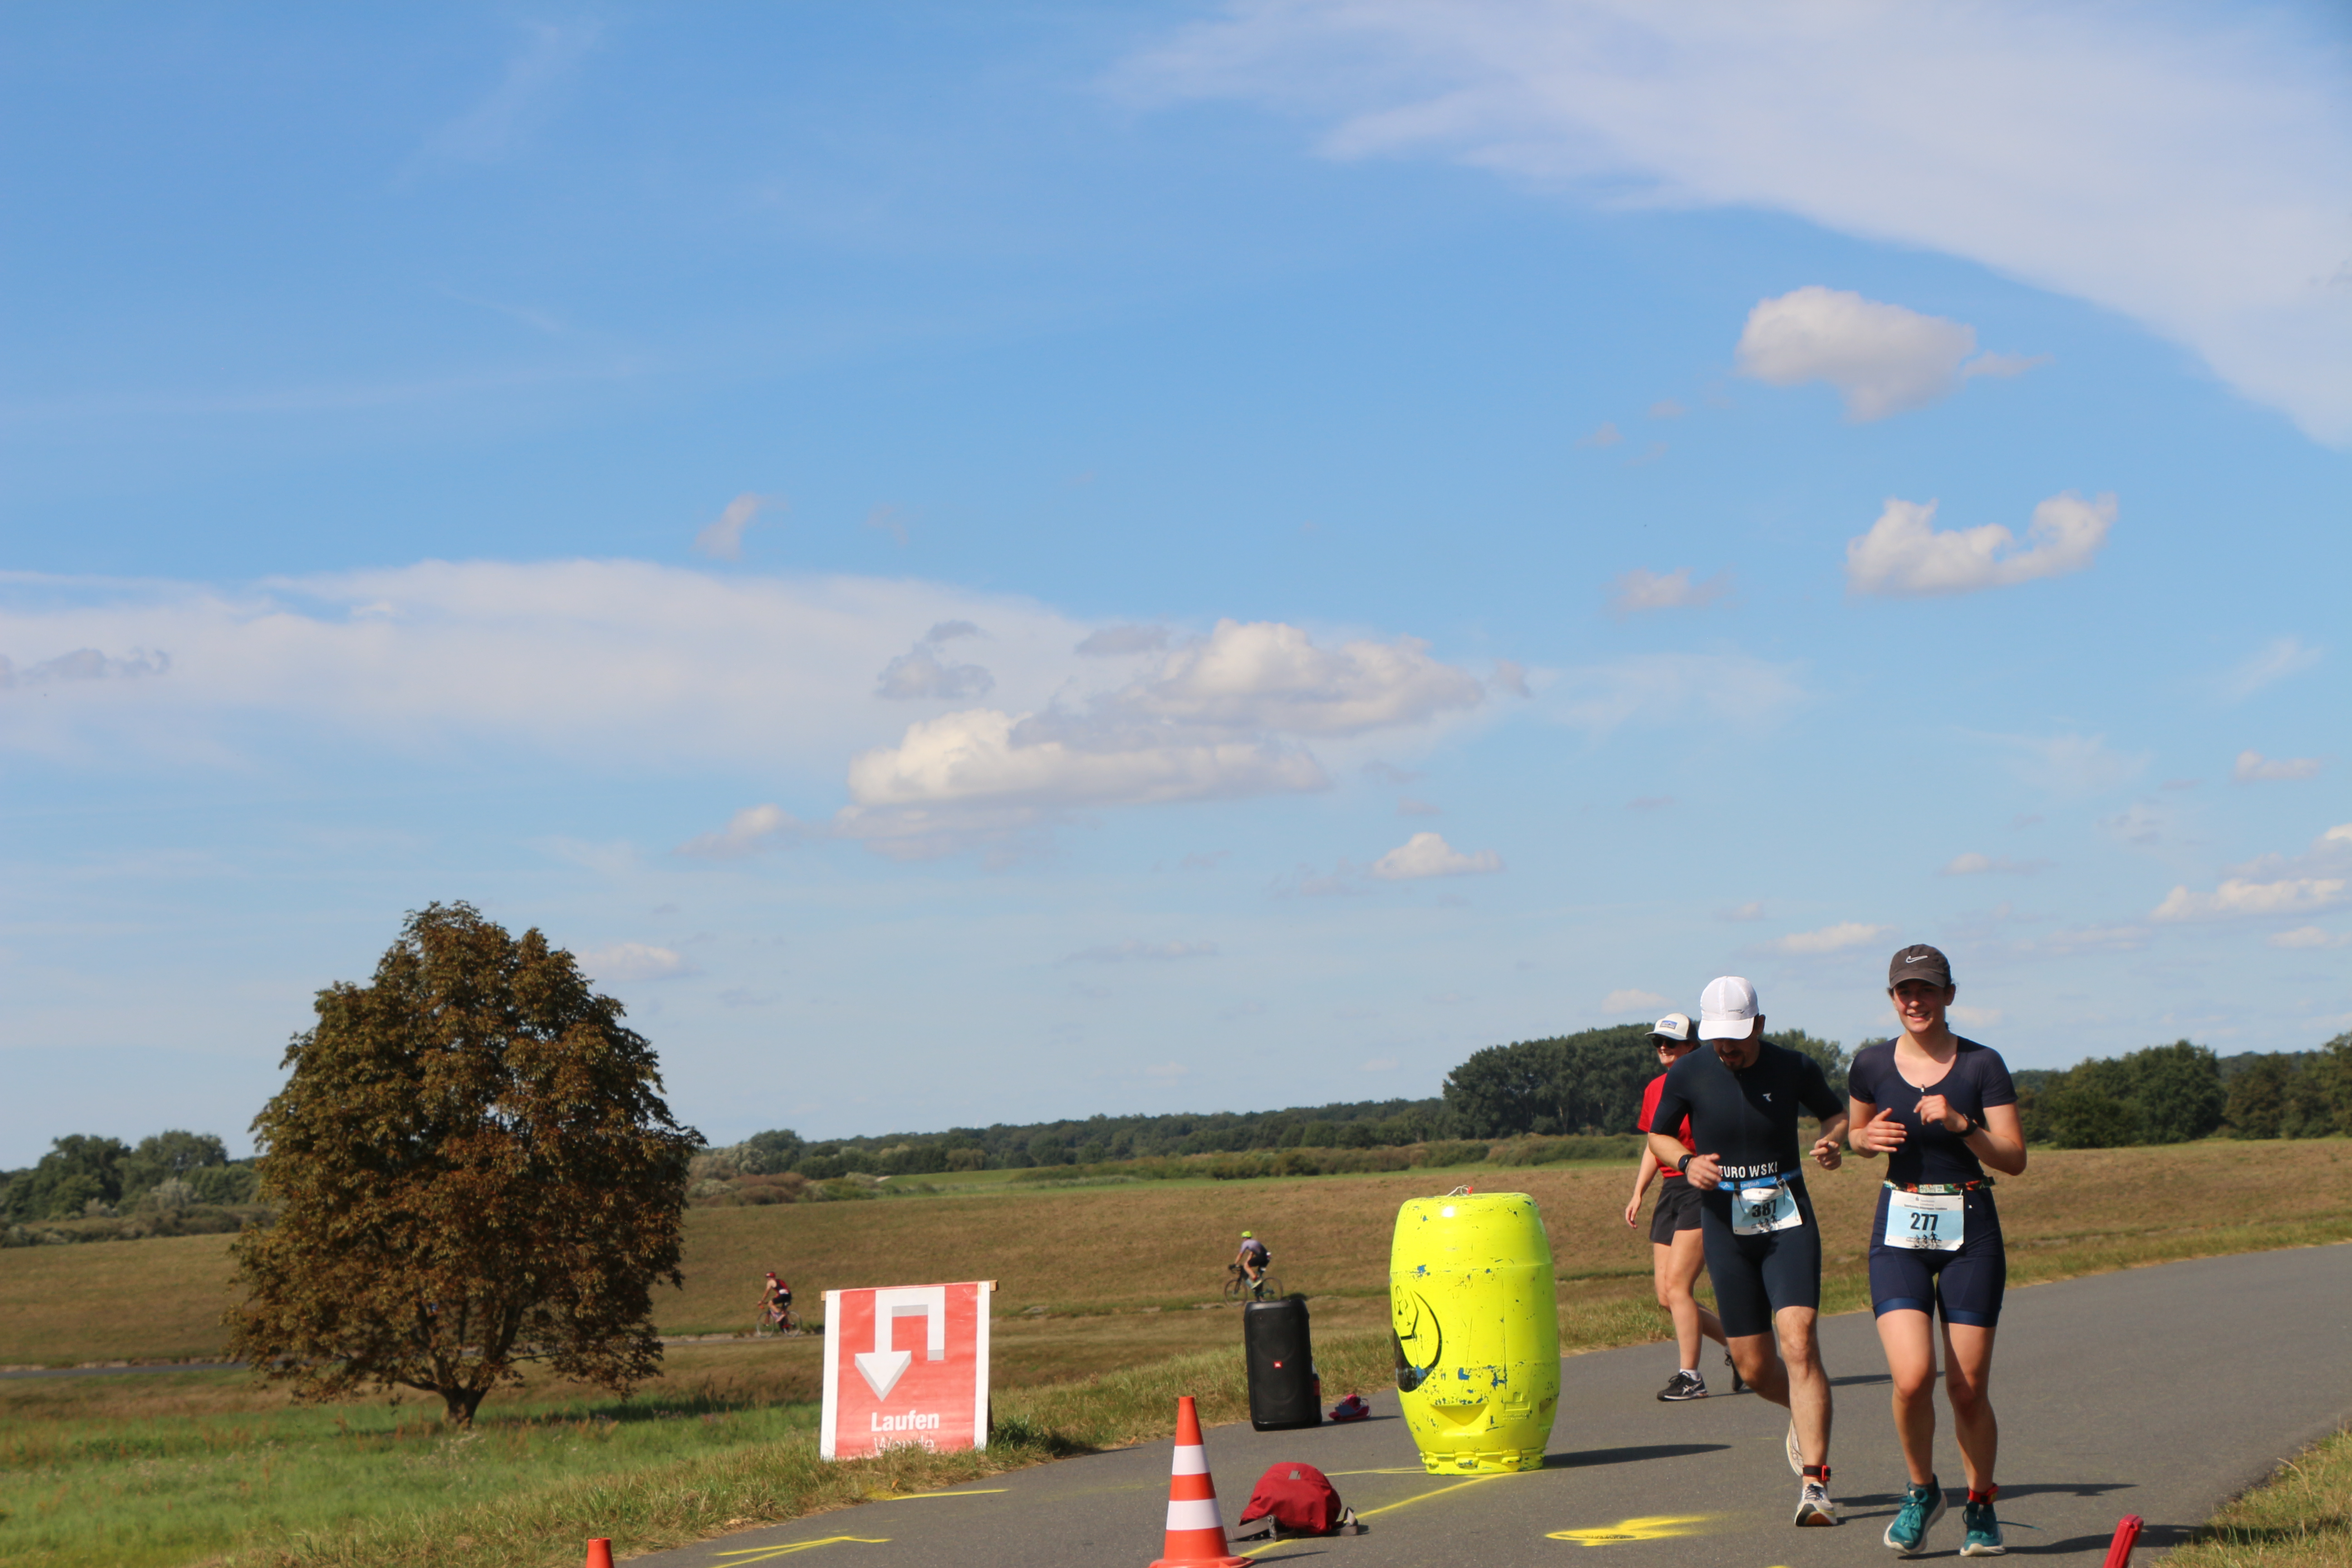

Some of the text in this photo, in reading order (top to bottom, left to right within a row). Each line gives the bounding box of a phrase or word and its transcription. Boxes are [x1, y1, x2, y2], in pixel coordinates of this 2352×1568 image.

[1752, 1199, 1778, 1218] 387
[1911, 1212, 1938, 1231] 277
[871, 1410, 940, 1432] Laufen
